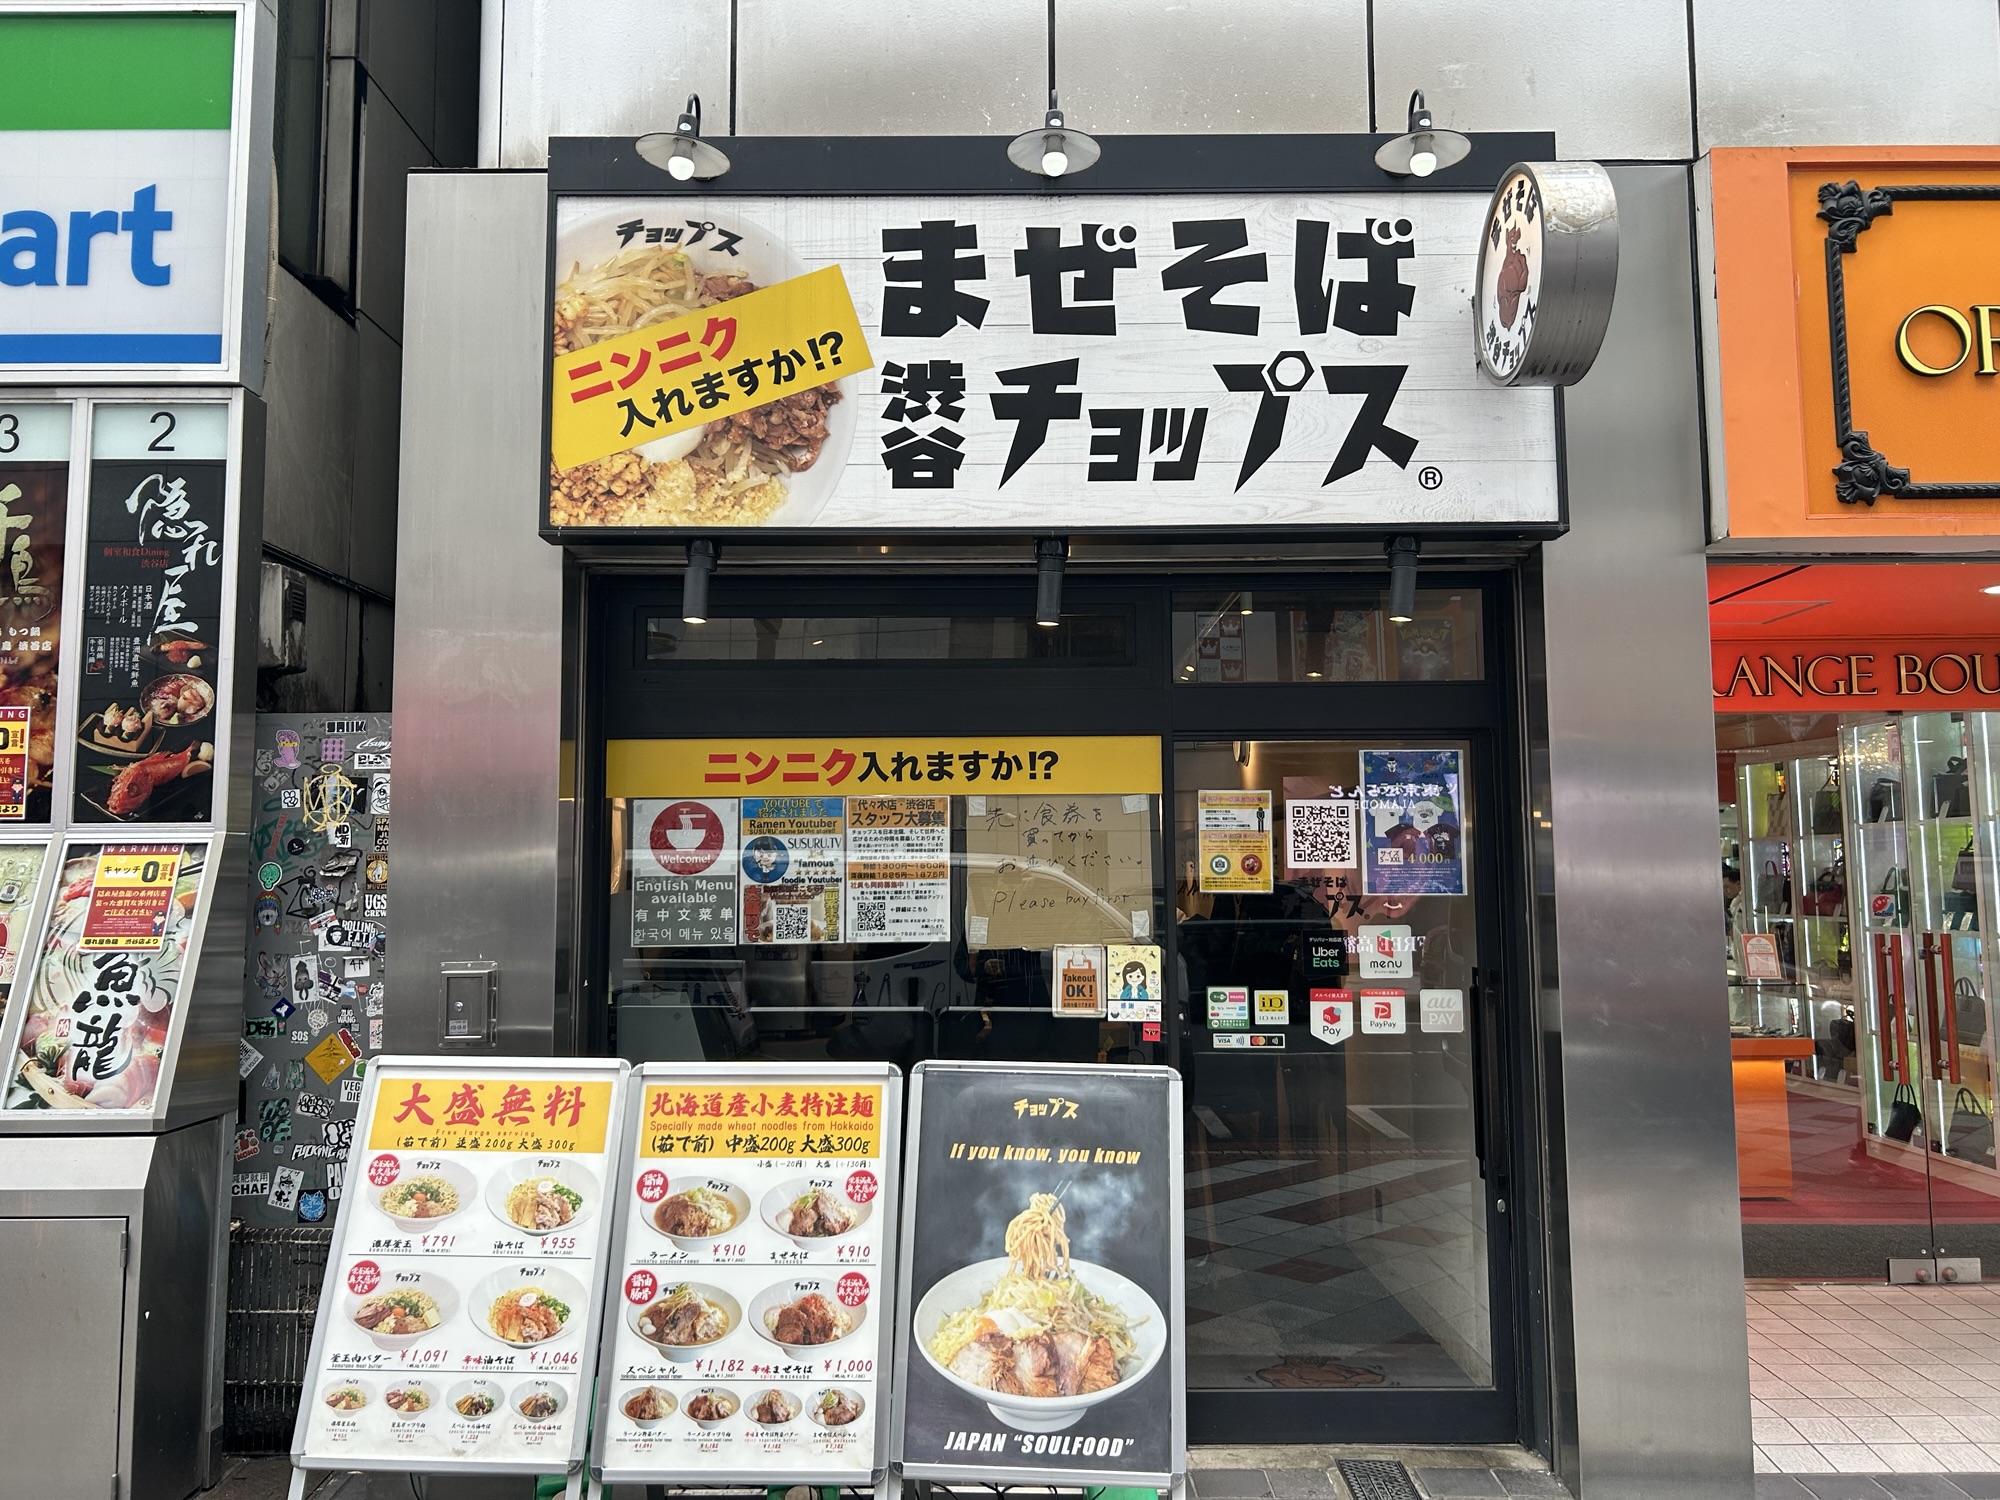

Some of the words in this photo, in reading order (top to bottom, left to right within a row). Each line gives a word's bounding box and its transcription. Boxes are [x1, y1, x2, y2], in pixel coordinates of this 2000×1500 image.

[615, 218, 743, 257] チョップス
[881, 217, 1417, 337] まぜそば
[568, 316, 738, 404] ニンニク
[147, 411, 177, 452] 2
[144, 585, 153, 609] 日本酒
[119, 585, 129, 624] ハイボール
[1714, 653, 1878, 698] ANGE
[858, 799, 936, 811] 代々木店・渋谷店
[758, 808, 827, 818] 紹介されました
[851, 811, 946, 827] スタッフ大募集
[985, 801, 1103, 832] 先に食券を
[749, 819, 786, 829] Ramen
[788, 819, 838, 829] Youtuber
[788, 838, 842, 849] SUSURU.TV
[1022, 827, 1094, 847] 買ってから
[107, 845, 179, 853] WARNING
[660, 853, 711, 864] Welcome!
[636, 880, 689, 893] English
[695, 880, 733, 891] Menu
[781, 876, 806, 884] foodie
[807, 876, 843, 884] Youtuber
[364, 894, 387, 910] UGS
[651, 892, 718, 904] available
[993, 889, 1056, 916] Please
[1065, 890, 1090, 908] buy
[634, 928, 672, 942] 한국어
[679, 928, 704, 941] 메뉴
[1312, 947, 1339, 957] Uber
[1313, 958, 1340, 968] Eats
[1370, 960, 1402, 969] menu
[1063, 973, 1096, 982] Takeout
[1065, 984, 1093, 998] OK!
[1261, 997, 1283, 1008] iD
[1427, 997, 1457, 1009] au
[1370, 1020, 1396, 1028] PayPay
[1428, 1013, 1455, 1025] PAY
[291, 1030, 309, 1042] SOS
[1322, 1025, 1341, 1036] Pay
[343, 1081, 362, 1091] VEG
[393, 1082, 586, 1128] 大盛無料
[649, 1091, 874, 1118] 北海道産小麦特注麺
[1013, 1097, 1080, 1120] チョップス
[649, 1120, 693, 1133] Specially
[697, 1120, 723, 1131] made
[727, 1121, 756, 1131] wheat
[761, 1120, 798, 1131] noodles
[802, 1120, 824, 1131] from
[829, 1120, 874, 1131] Hokkaido
[484, 1138, 513, 1150] 200g
[547, 1139, 576, 1151] 300g
[950, 1143, 966, 1160] If
[967, 1146, 1001, 1163] you
[1003, 1144, 1054, 1163] know,
[1057, 1149, 1091, 1165] you
[1094, 1147, 1141, 1166] know
[416, 1160, 441, 1170] チョップス
[537, 1159, 561, 1169] チョップス
[231, 1183, 268, 1196] CHAF
[707, 1180, 730, 1192] チョップス
[808, 1179, 833, 1188] チョップス
[493, 1240, 525, 1249] 油そば
[540, 1236, 576, 1249] ¥955
[650, 1251, 688, 1260] ラーメン
[712, 1244, 746, 1256] ¥910
[770, 1251, 809, 1260] まぜそば
[837, 1245, 871, 1258] ¥910
[395, 1272, 422, 1283] チョップス
[794, 1281, 820, 1291] チョップス
[399, 1349, 449, 1364] ¥1,091
[462, 1355, 516, 1365] 辛味油そば
[529, 1351, 578, 1366] ¥1,046
[626, 1365, 678, 1374] スペシャル
[695, 1359, 745, 1374] ¥1,182
[751, 1365, 813, 1374] 辛味まぜそば
[824, 1359, 873, 1374] ¥1,000
[944, 1431, 1007, 1454] JAPAN
